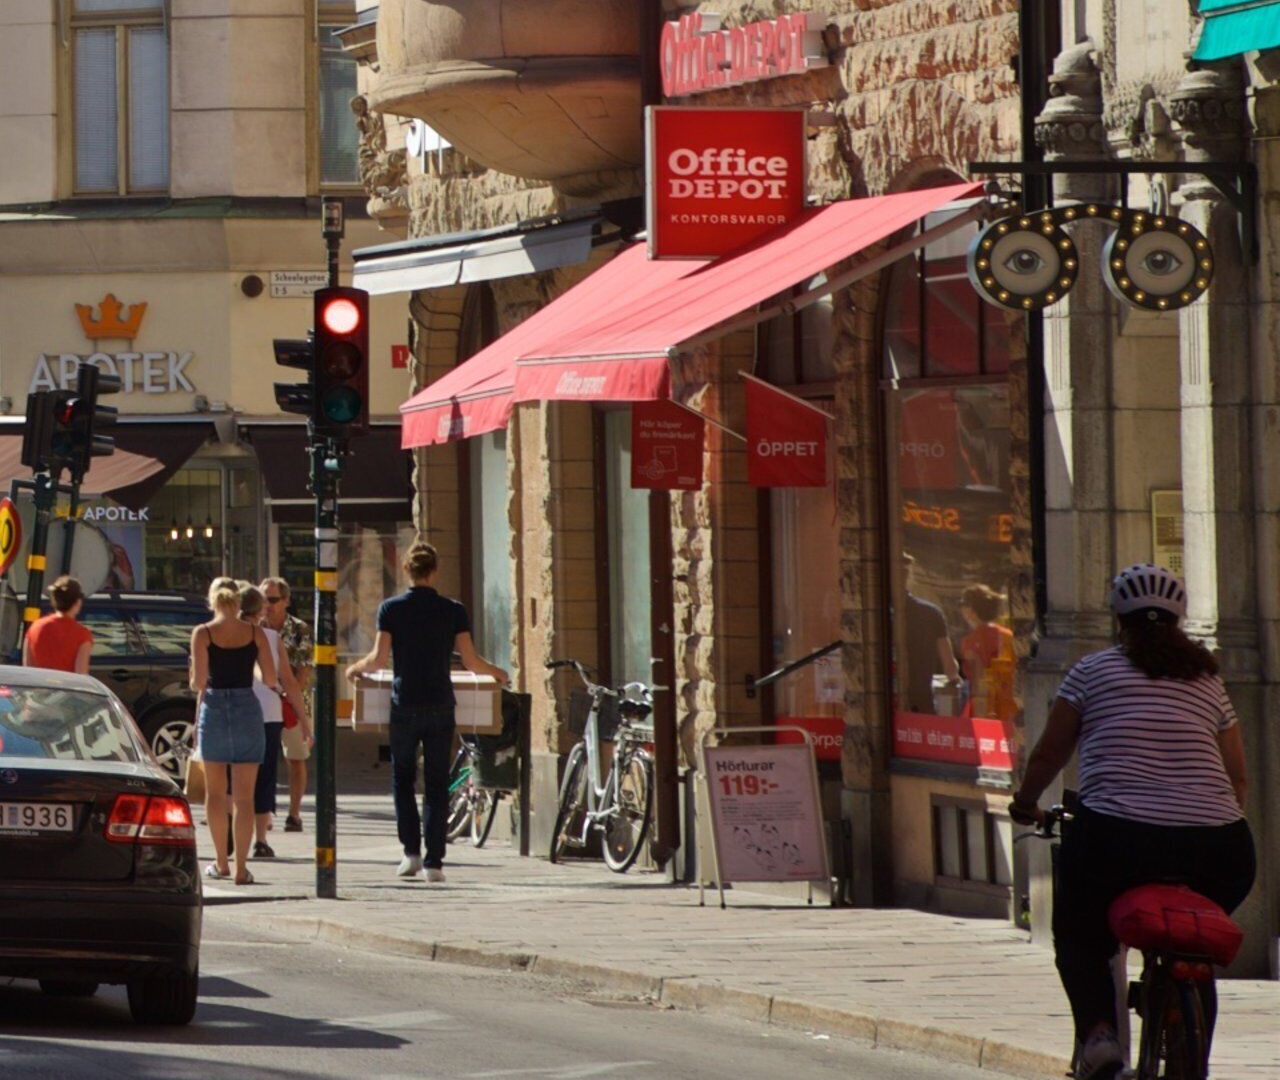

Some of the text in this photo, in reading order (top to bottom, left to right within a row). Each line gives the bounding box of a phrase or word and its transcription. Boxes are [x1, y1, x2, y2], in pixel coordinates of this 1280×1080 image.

[668, 148, 788, 176] Office
[669, 179, 787, 199] DEPOT
[671, 214, 786, 225] KONTORSVAROR
[756, 438, 819, 457] ÖPPET
[83, 506, 149, 520] APOTEK
[719, 774, 779, 796] 119:-
[22, 806, 67, 827] 936
